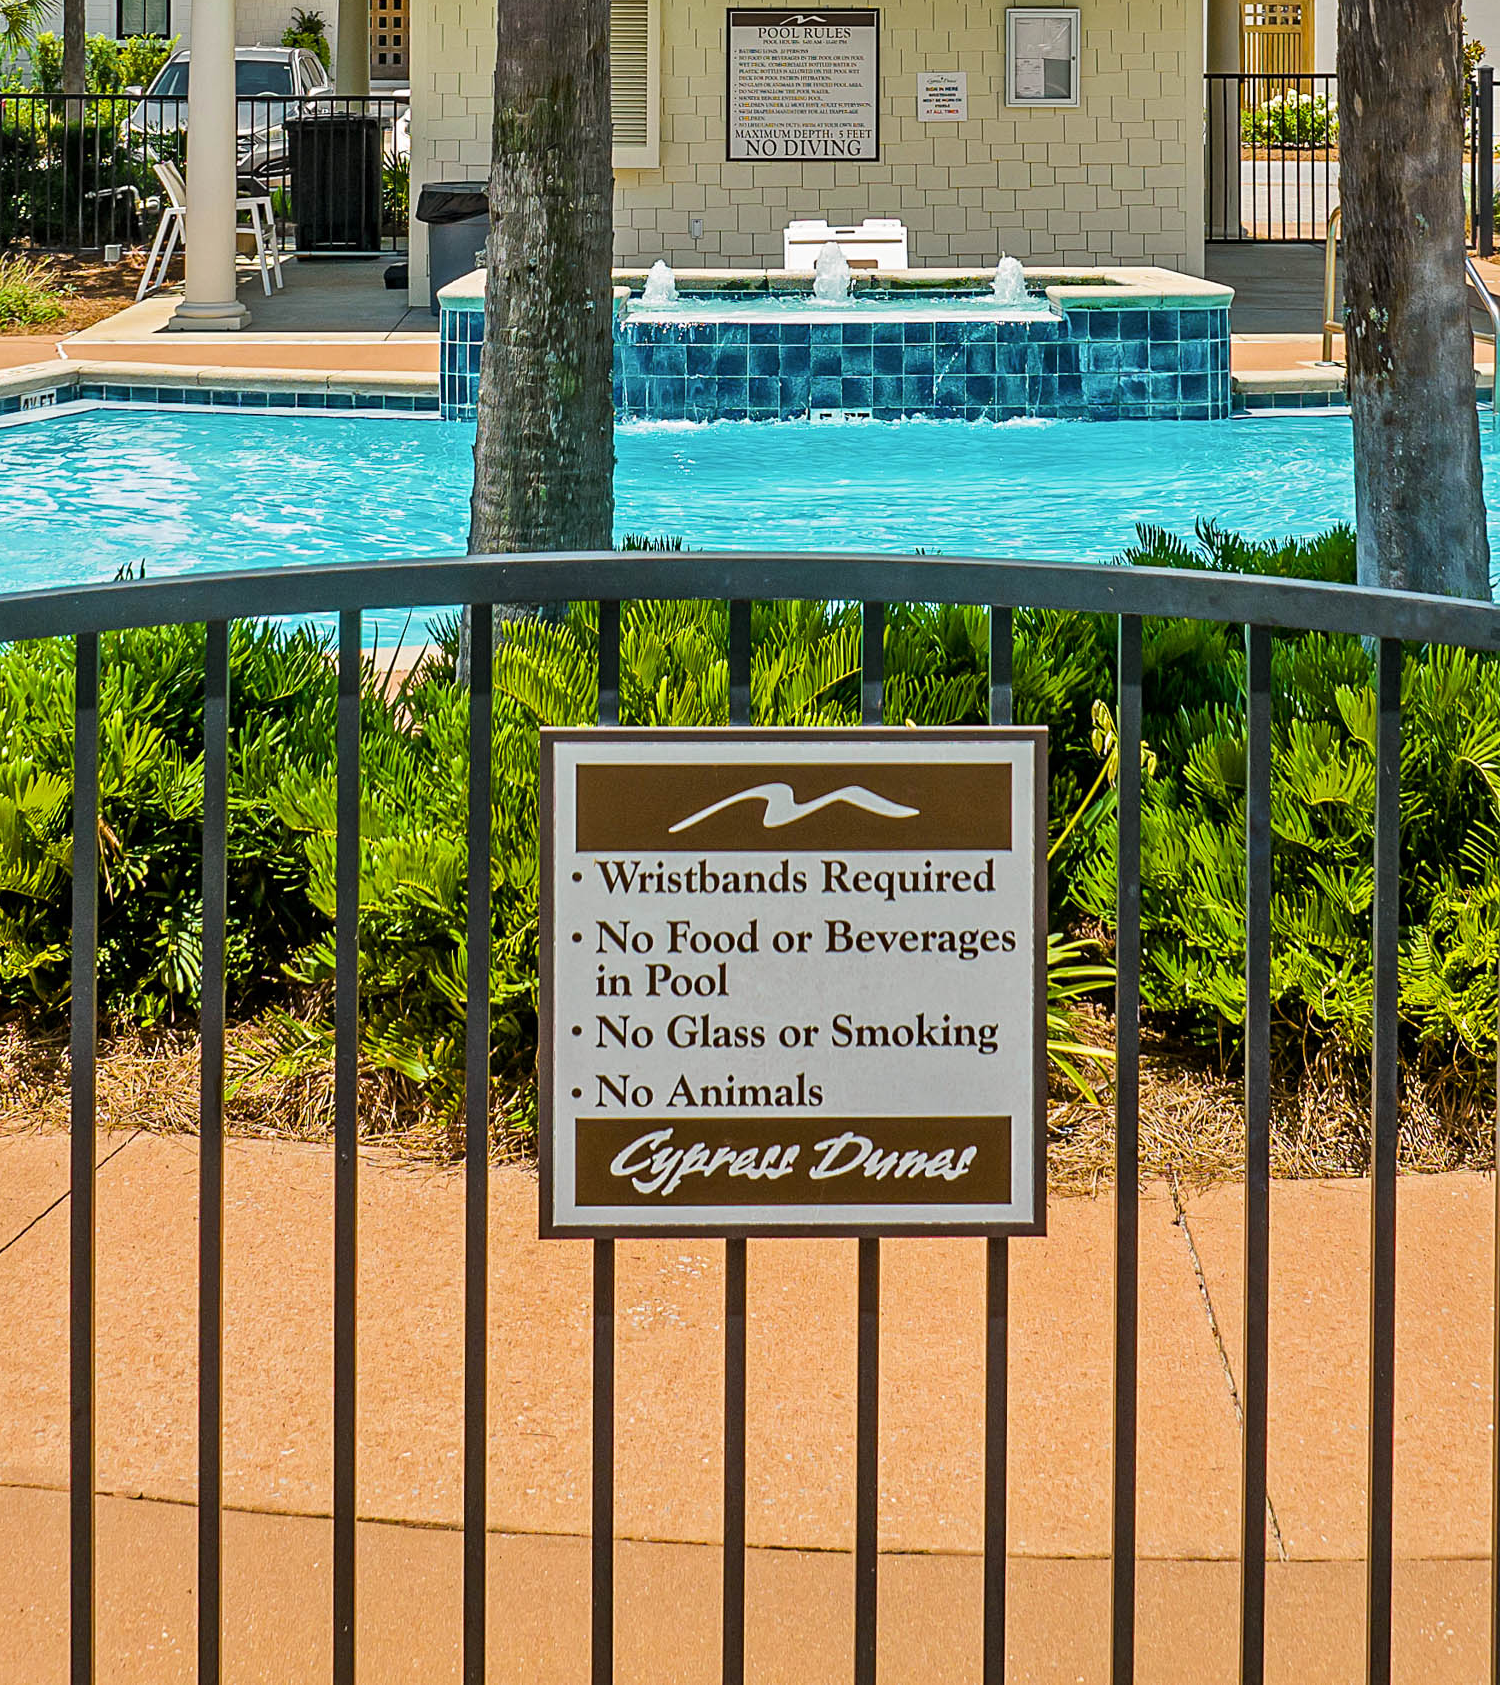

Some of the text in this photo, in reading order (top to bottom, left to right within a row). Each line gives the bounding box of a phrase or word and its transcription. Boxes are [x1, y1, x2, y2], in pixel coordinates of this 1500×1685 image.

[758, 28, 852, 38] POOL RULES
[736, 130, 872, 138] MAXIMUM DEPTH: 5 FEET
[746, 139, 862, 156] NO DIVING
[595, 859, 995, 901] Wristbands Required
[596, 919, 1015, 960] No Food or Beverages
[596, 962, 728, 996] in Pool
[596, 1013, 998, 1054] No Glass or Smoking
[596, 1073, 822, 1107] No Animals
[610, 1128, 977, 1196] Cypress Dunes
